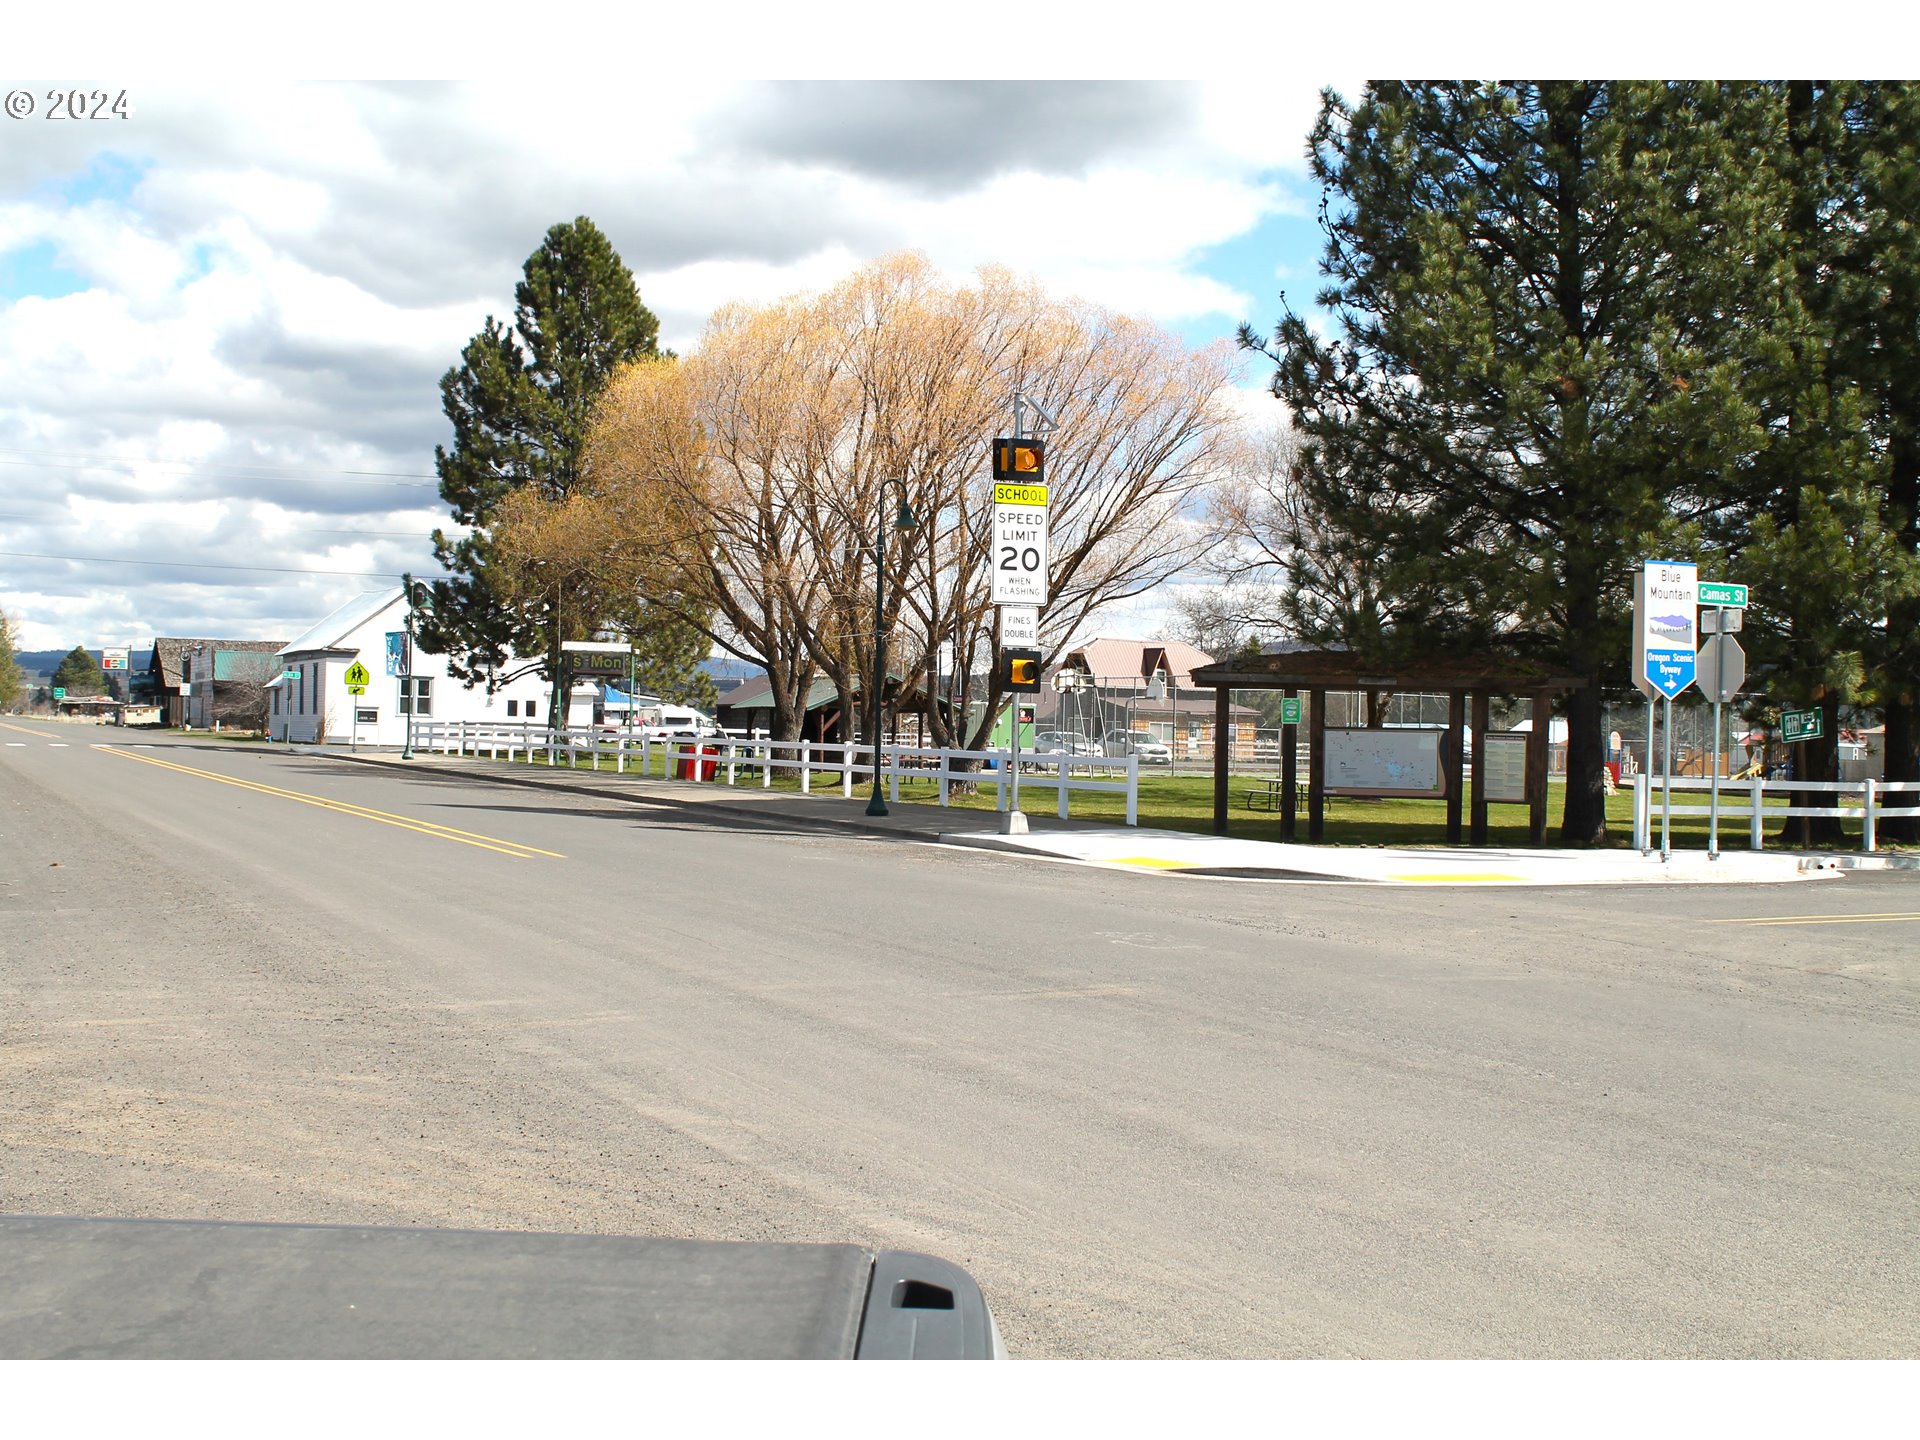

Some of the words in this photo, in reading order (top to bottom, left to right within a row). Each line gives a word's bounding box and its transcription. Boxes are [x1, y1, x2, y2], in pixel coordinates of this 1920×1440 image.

[998, 488, 1044, 502] SCHOOL
[998, 512, 1044, 525] SPEED
[1002, 529, 1038, 542] LIMIT
[1000, 546, 1040, 572] 20
[1008, 577, 1031, 585] WHEN
[1661, 569, 1681, 583] Blue
[999, 586, 1040, 597] FLASHING
[1650, 586, 1692, 601] Mountain
[1700, 586, 1731, 602] Camas
[1734, 589, 1745, 603] St
[1008, 616, 1031, 625] FINES
[1004, 629, 1034, 639] DOUBLE
[590, 654, 622, 668] Mon
[1647, 652, 1670, 664] Oregon
[1672, 652, 1694, 663] Scenic
[1659, 664, 1682, 676] Byway
